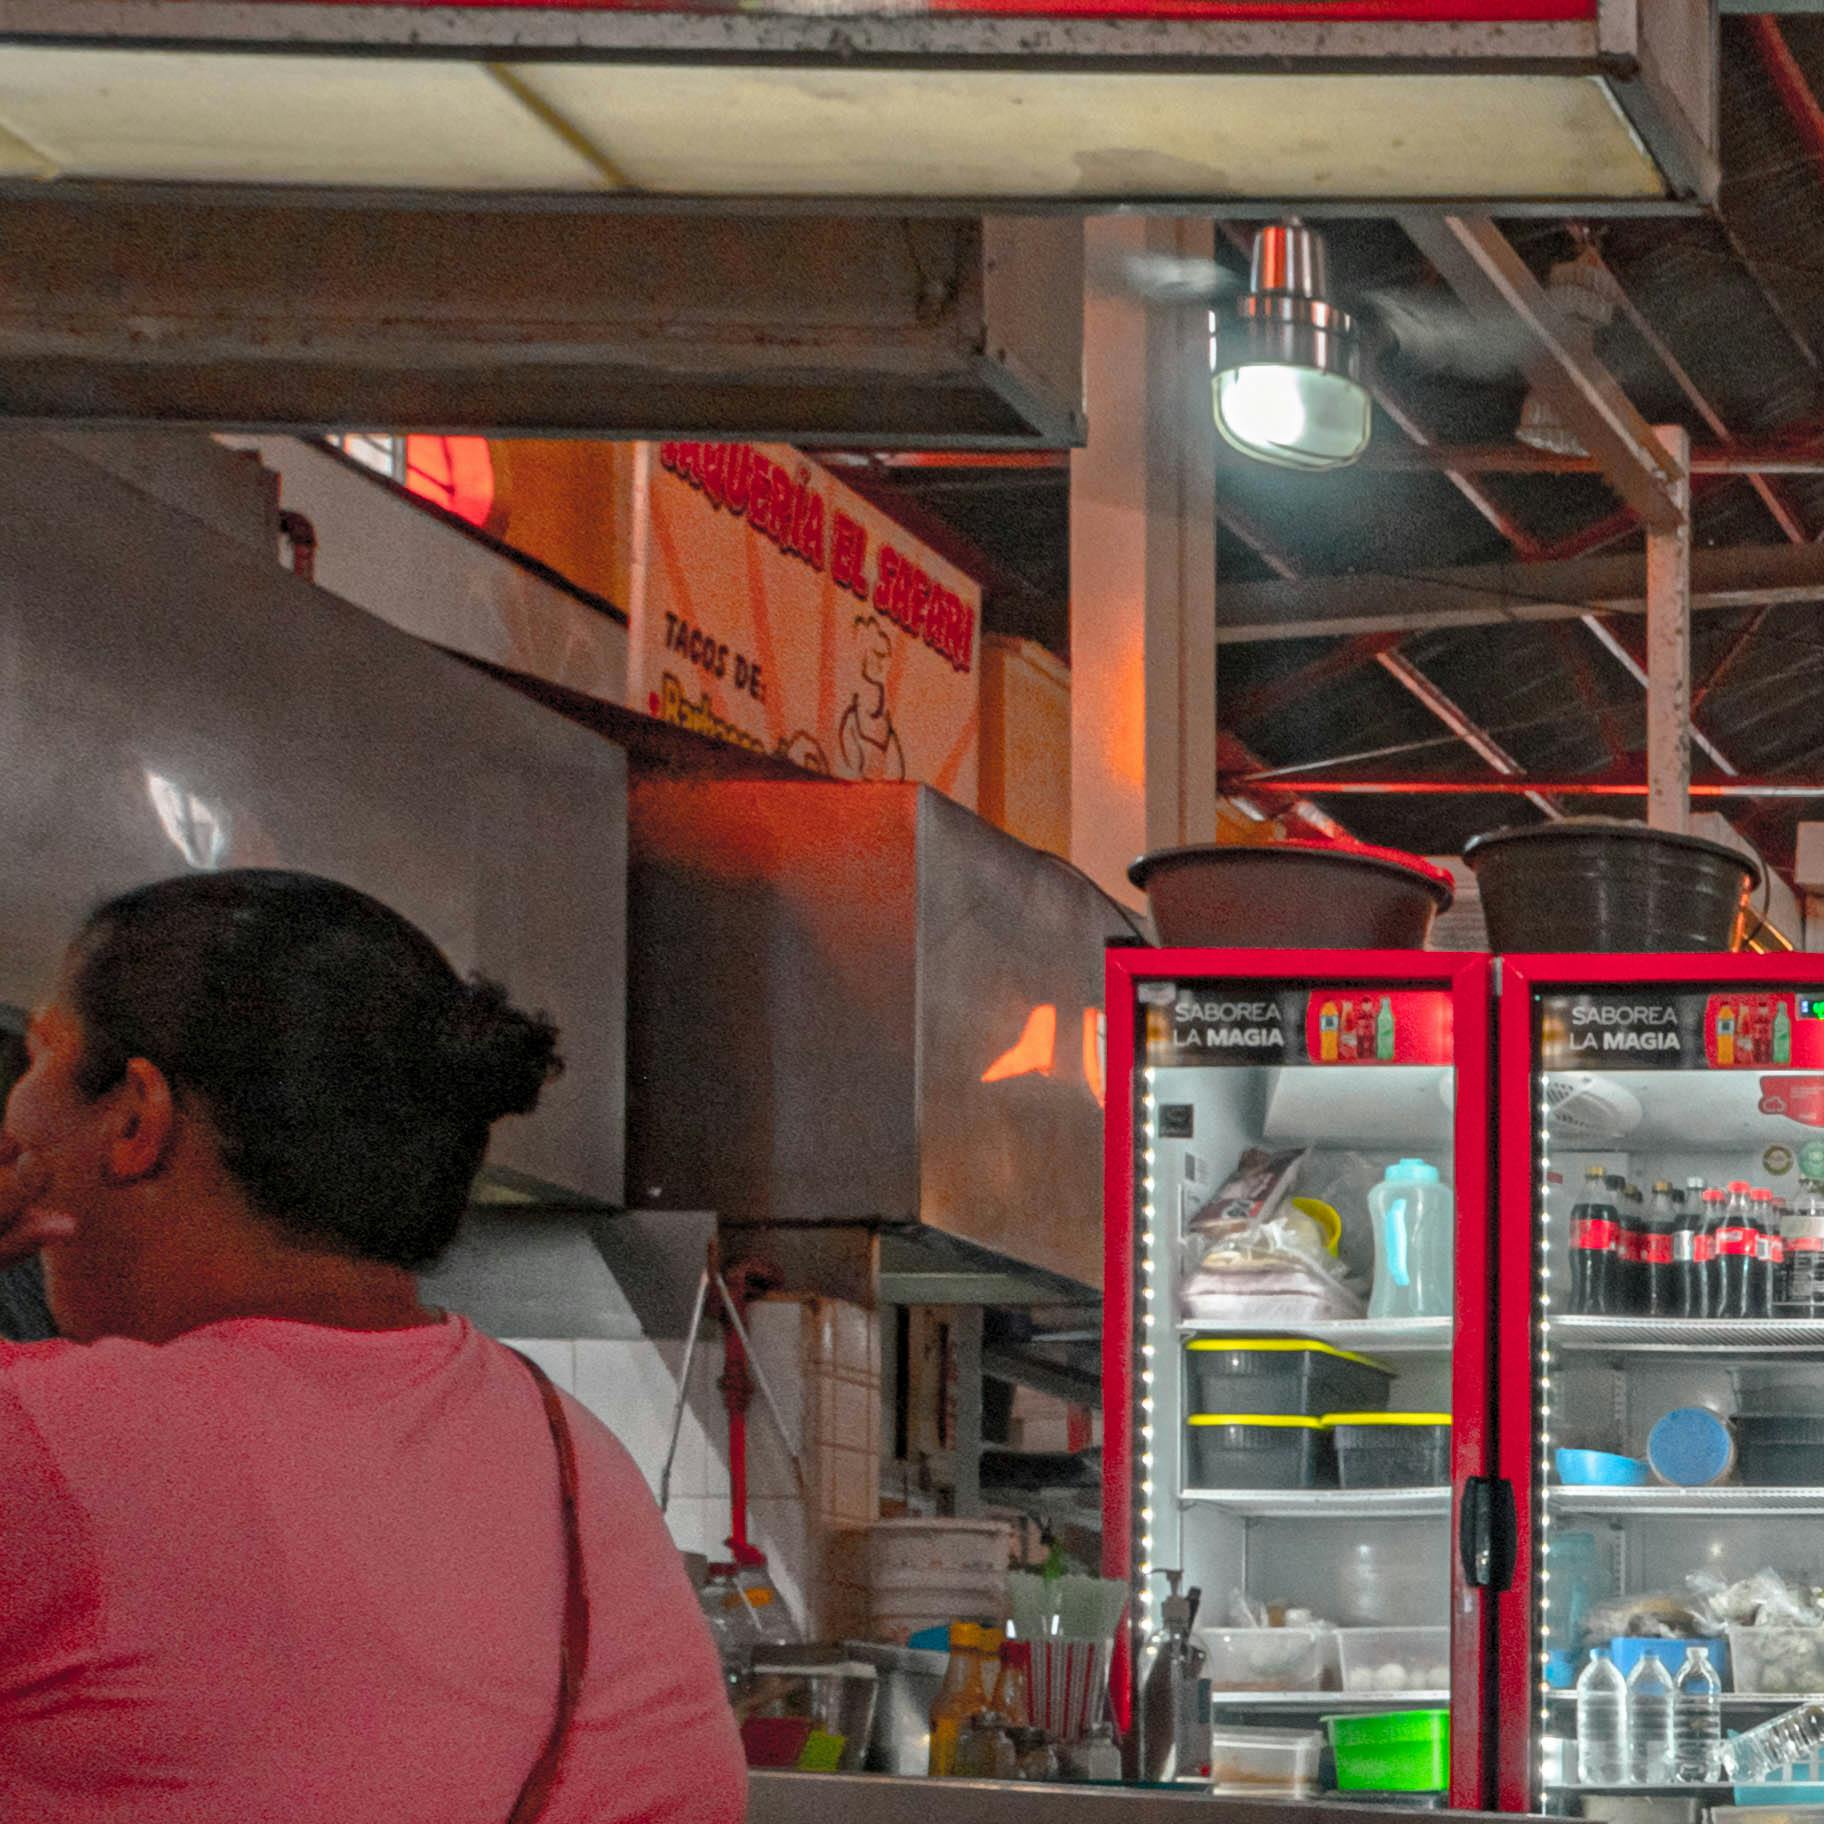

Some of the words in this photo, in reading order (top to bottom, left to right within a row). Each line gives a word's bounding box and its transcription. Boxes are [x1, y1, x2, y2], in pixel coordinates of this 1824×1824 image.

[832, 509, 870, 601] EL
[662, 613, 728, 677] TACOS
[1175, 1002, 1282, 1022] SABOREA
[1572, 1006, 1678, 1026] SABOREA
[1173, 1028, 1201, 1046] LA
[1207, 1028, 1285, 1047] MAGIA
[1569, 1031, 1598, 1050] LA
[1603, 1031, 1681, 1050] MAGIA
